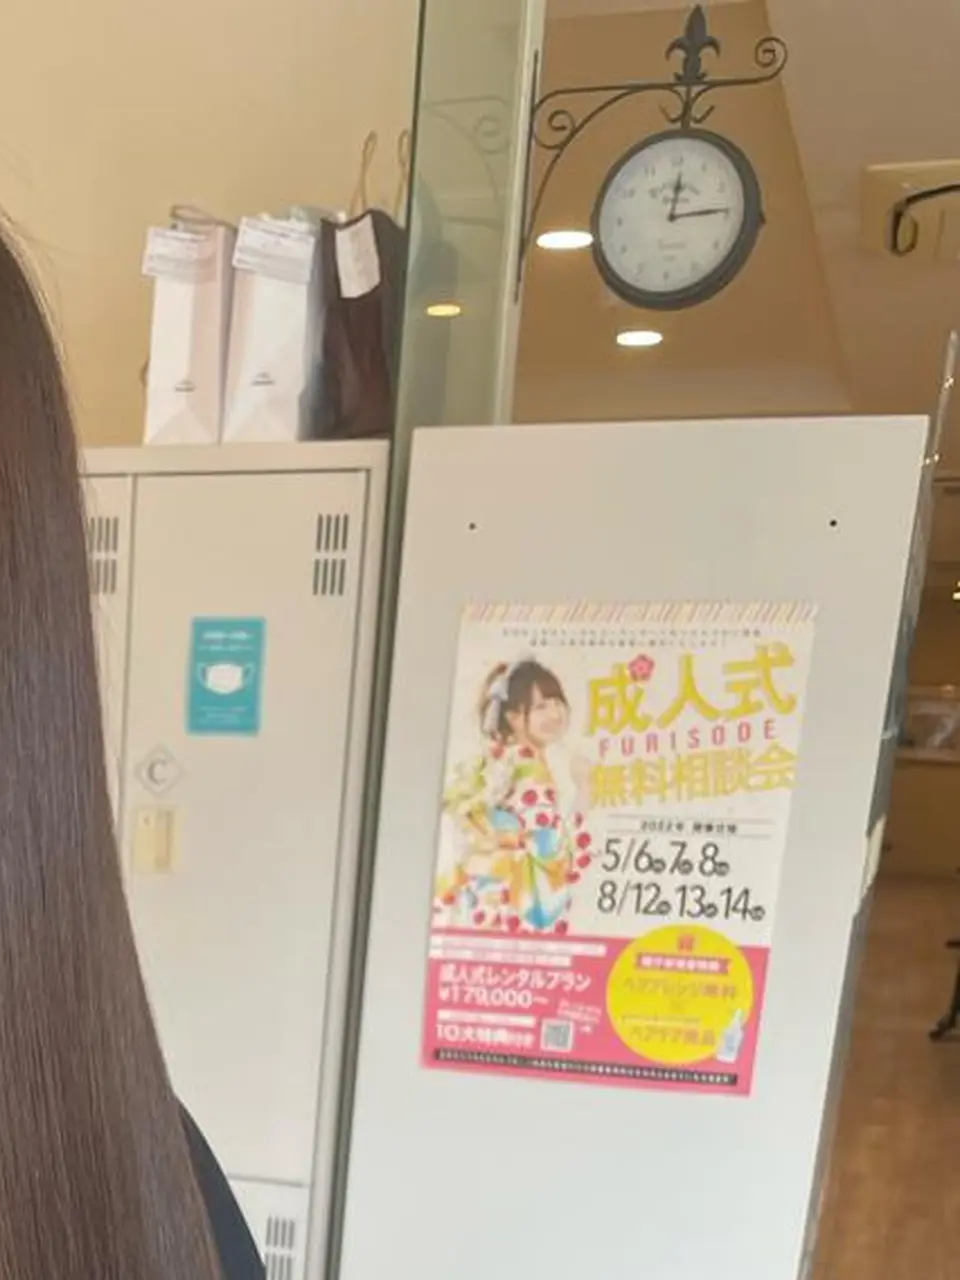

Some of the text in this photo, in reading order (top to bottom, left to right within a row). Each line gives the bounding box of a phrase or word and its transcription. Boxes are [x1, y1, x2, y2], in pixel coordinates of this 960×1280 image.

[583, 642, 796, 738] 成人式
[598, 718, 776, 758] FURISODE
[588, 740, 800, 808] 無料相談会
